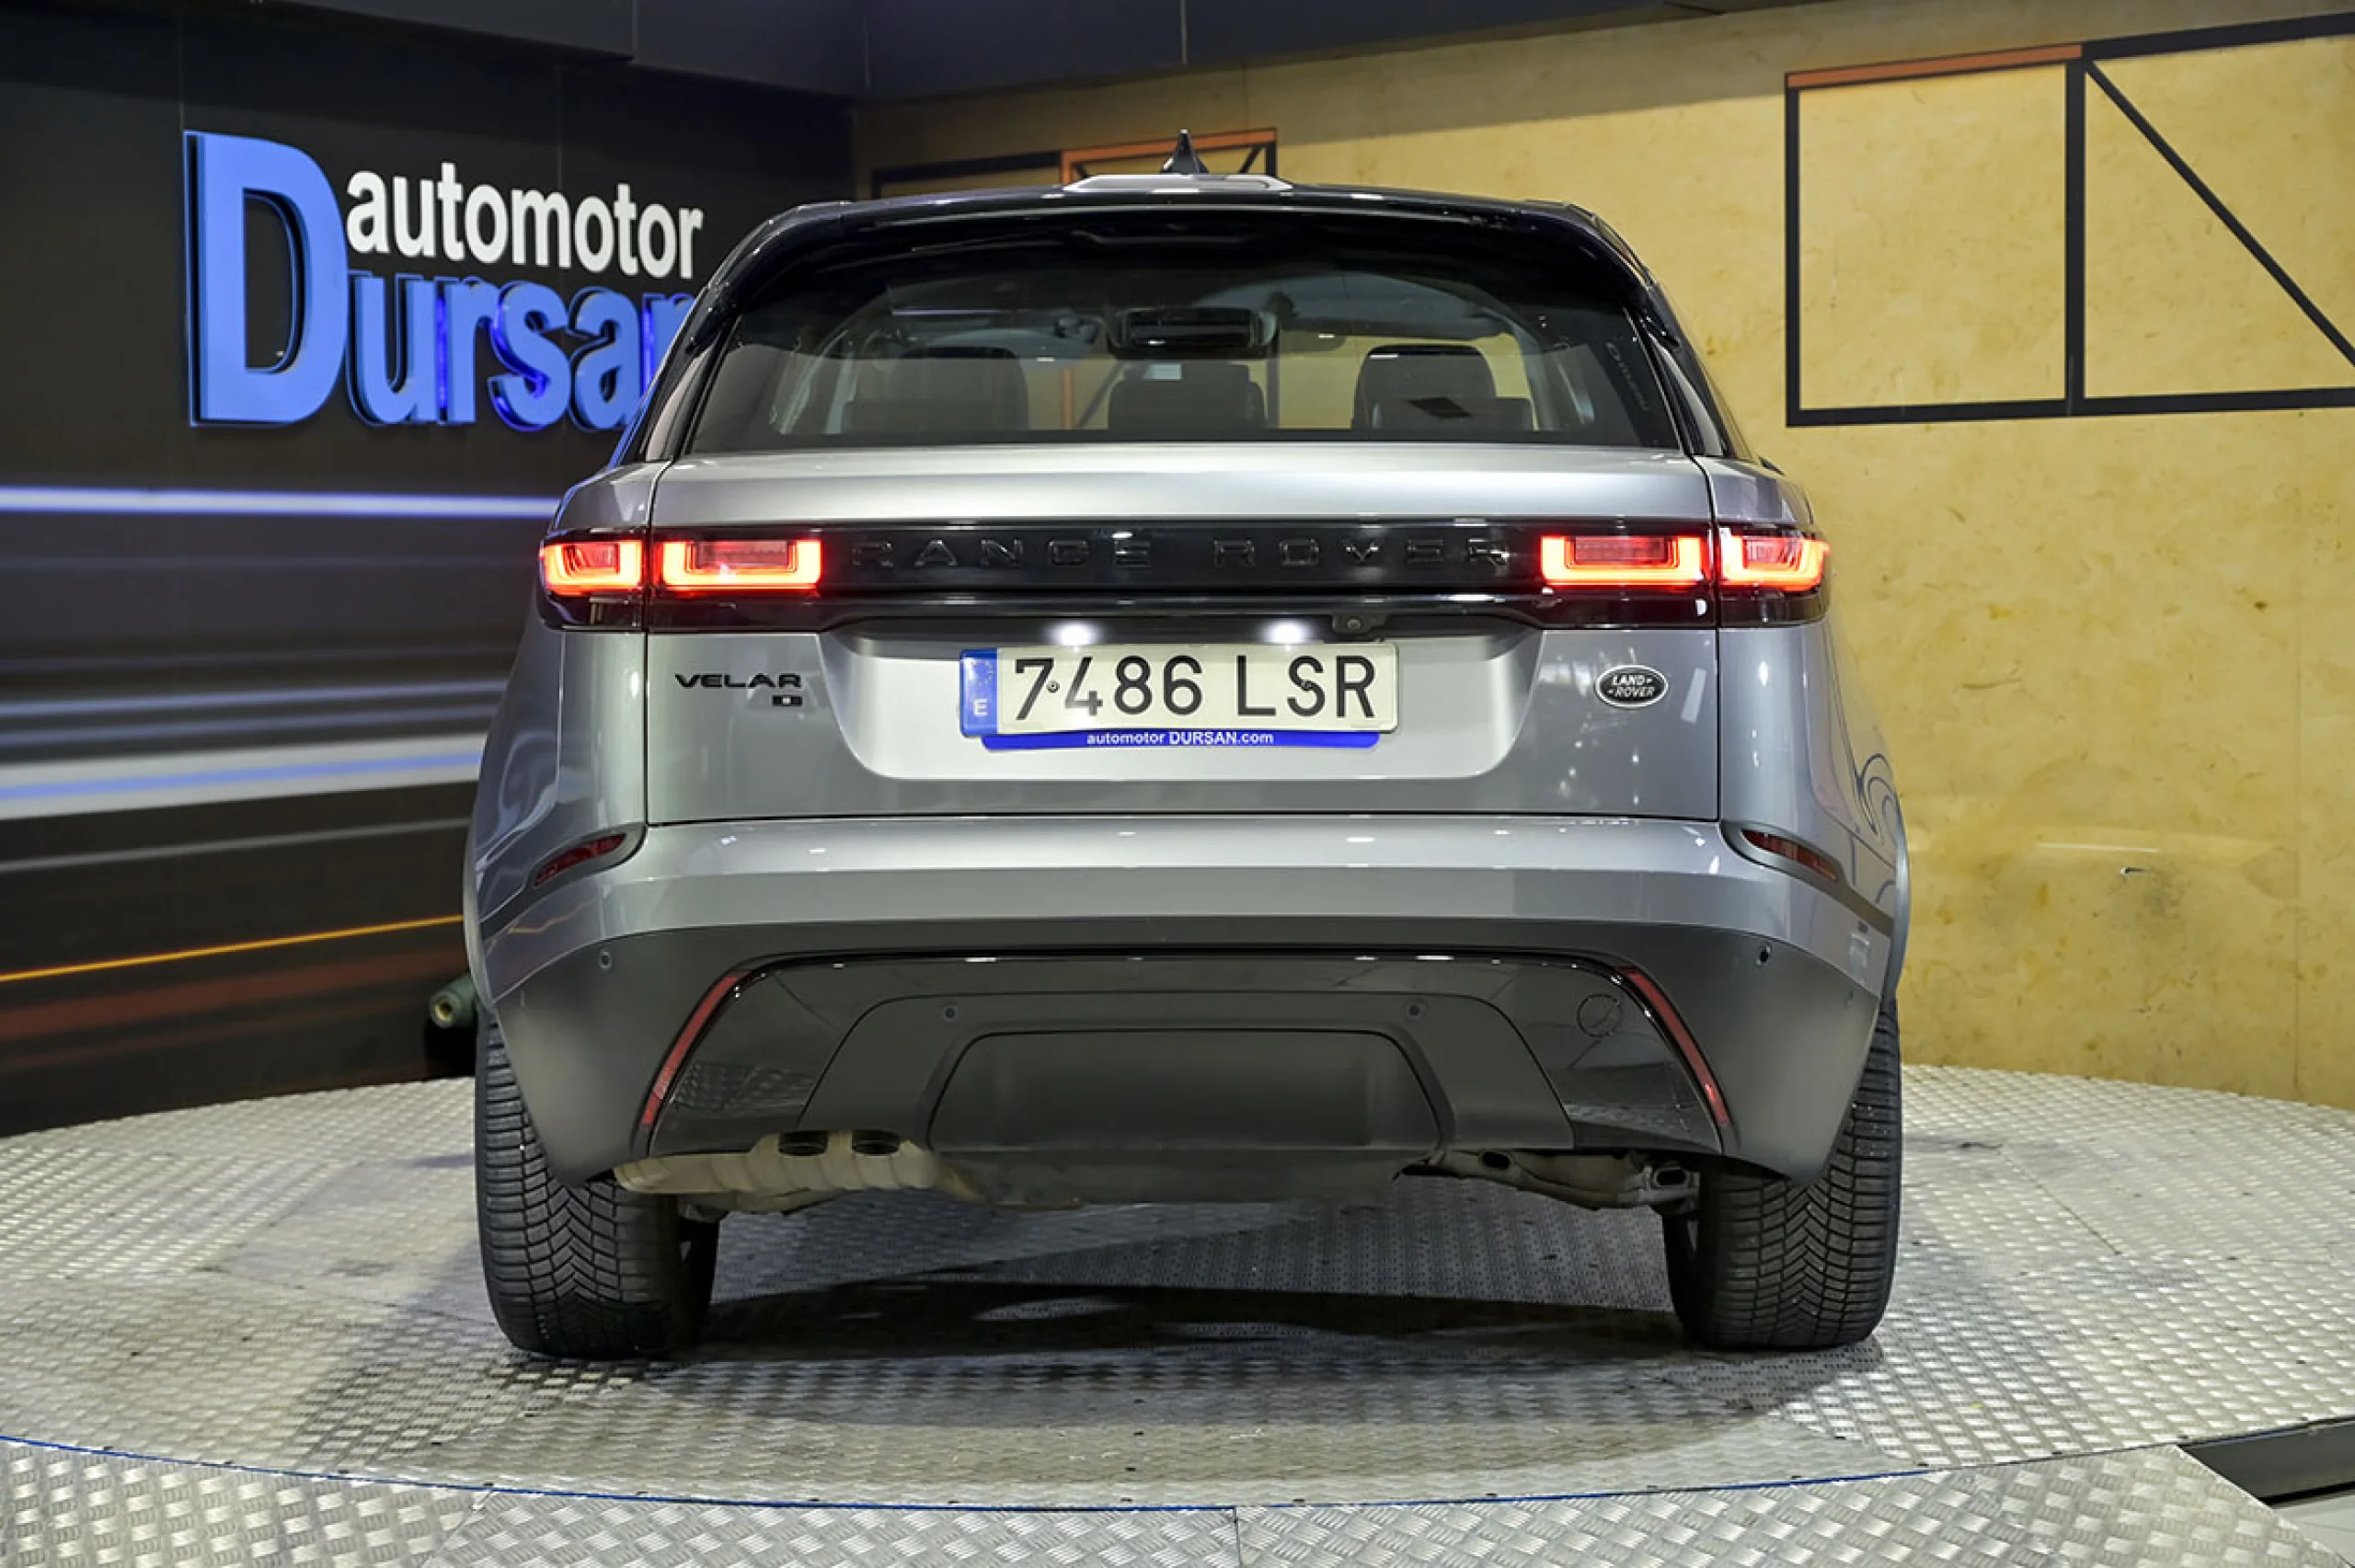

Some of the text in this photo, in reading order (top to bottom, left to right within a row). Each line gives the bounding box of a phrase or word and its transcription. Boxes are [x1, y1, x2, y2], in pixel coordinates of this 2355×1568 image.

[347, 163, 703, 279] automotor
[852, 538, 1511, 567] RANGE ROVER
[674, 673, 801, 688] VELAR
[972, 655, 1376, 720] E 7486 LSR
[1086, 732, 1274, 745] automotor DURSAN.com
